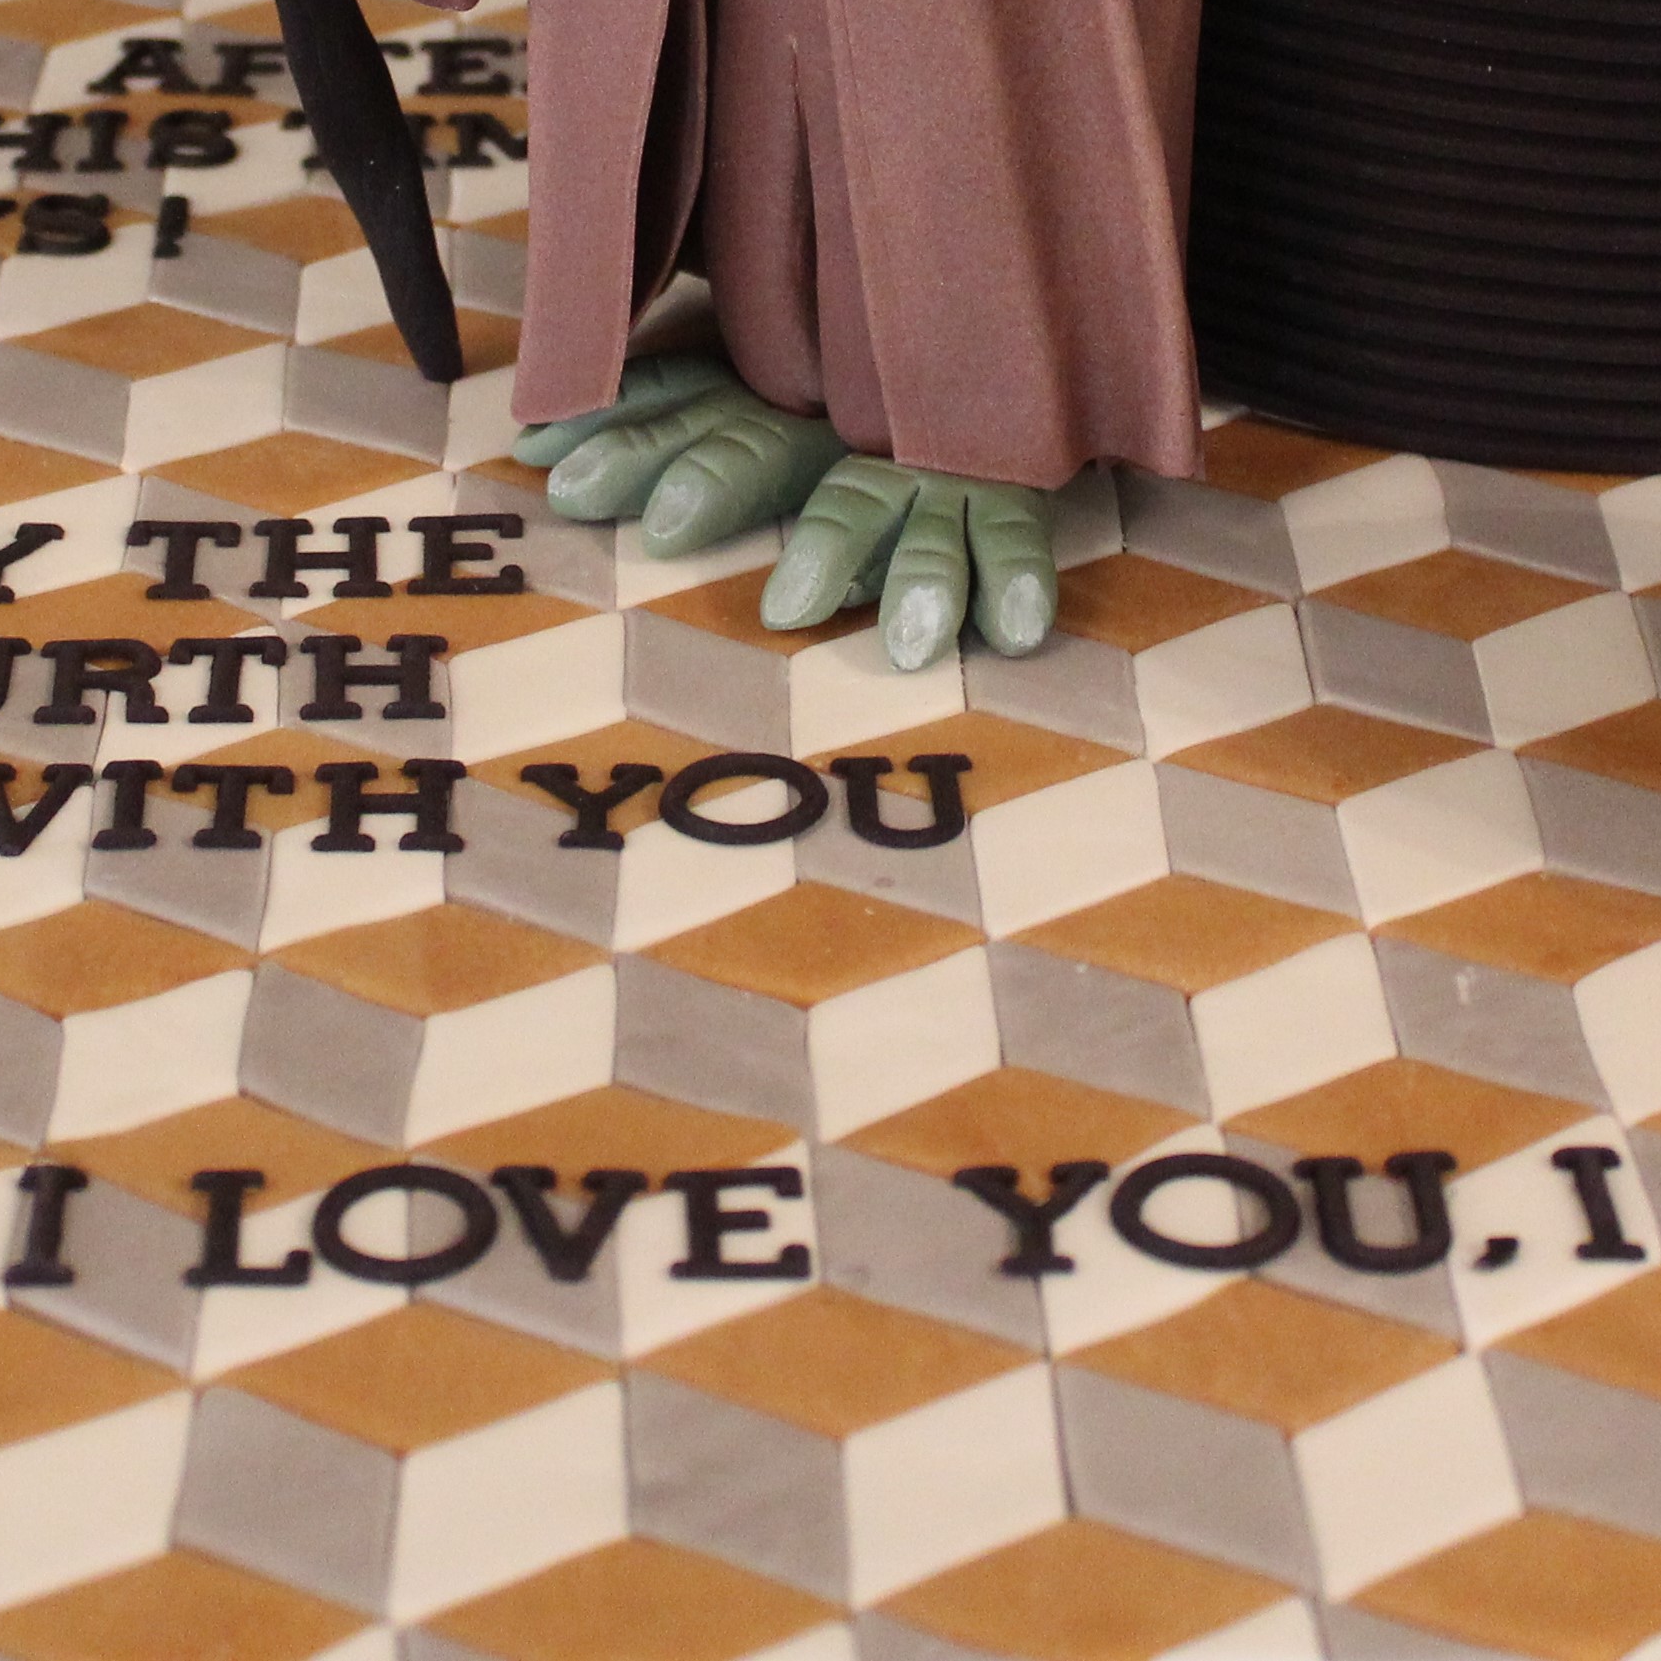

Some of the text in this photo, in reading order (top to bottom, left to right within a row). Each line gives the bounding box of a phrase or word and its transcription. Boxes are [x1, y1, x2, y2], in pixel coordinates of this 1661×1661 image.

[85, 36, 528, 98] AFE
[125, 511, 531, 603] THE
[518, 751, 974, 853] YOU
[4, 1163, 91, 1288] I
[184, 1161, 810, 1289] LOVE
